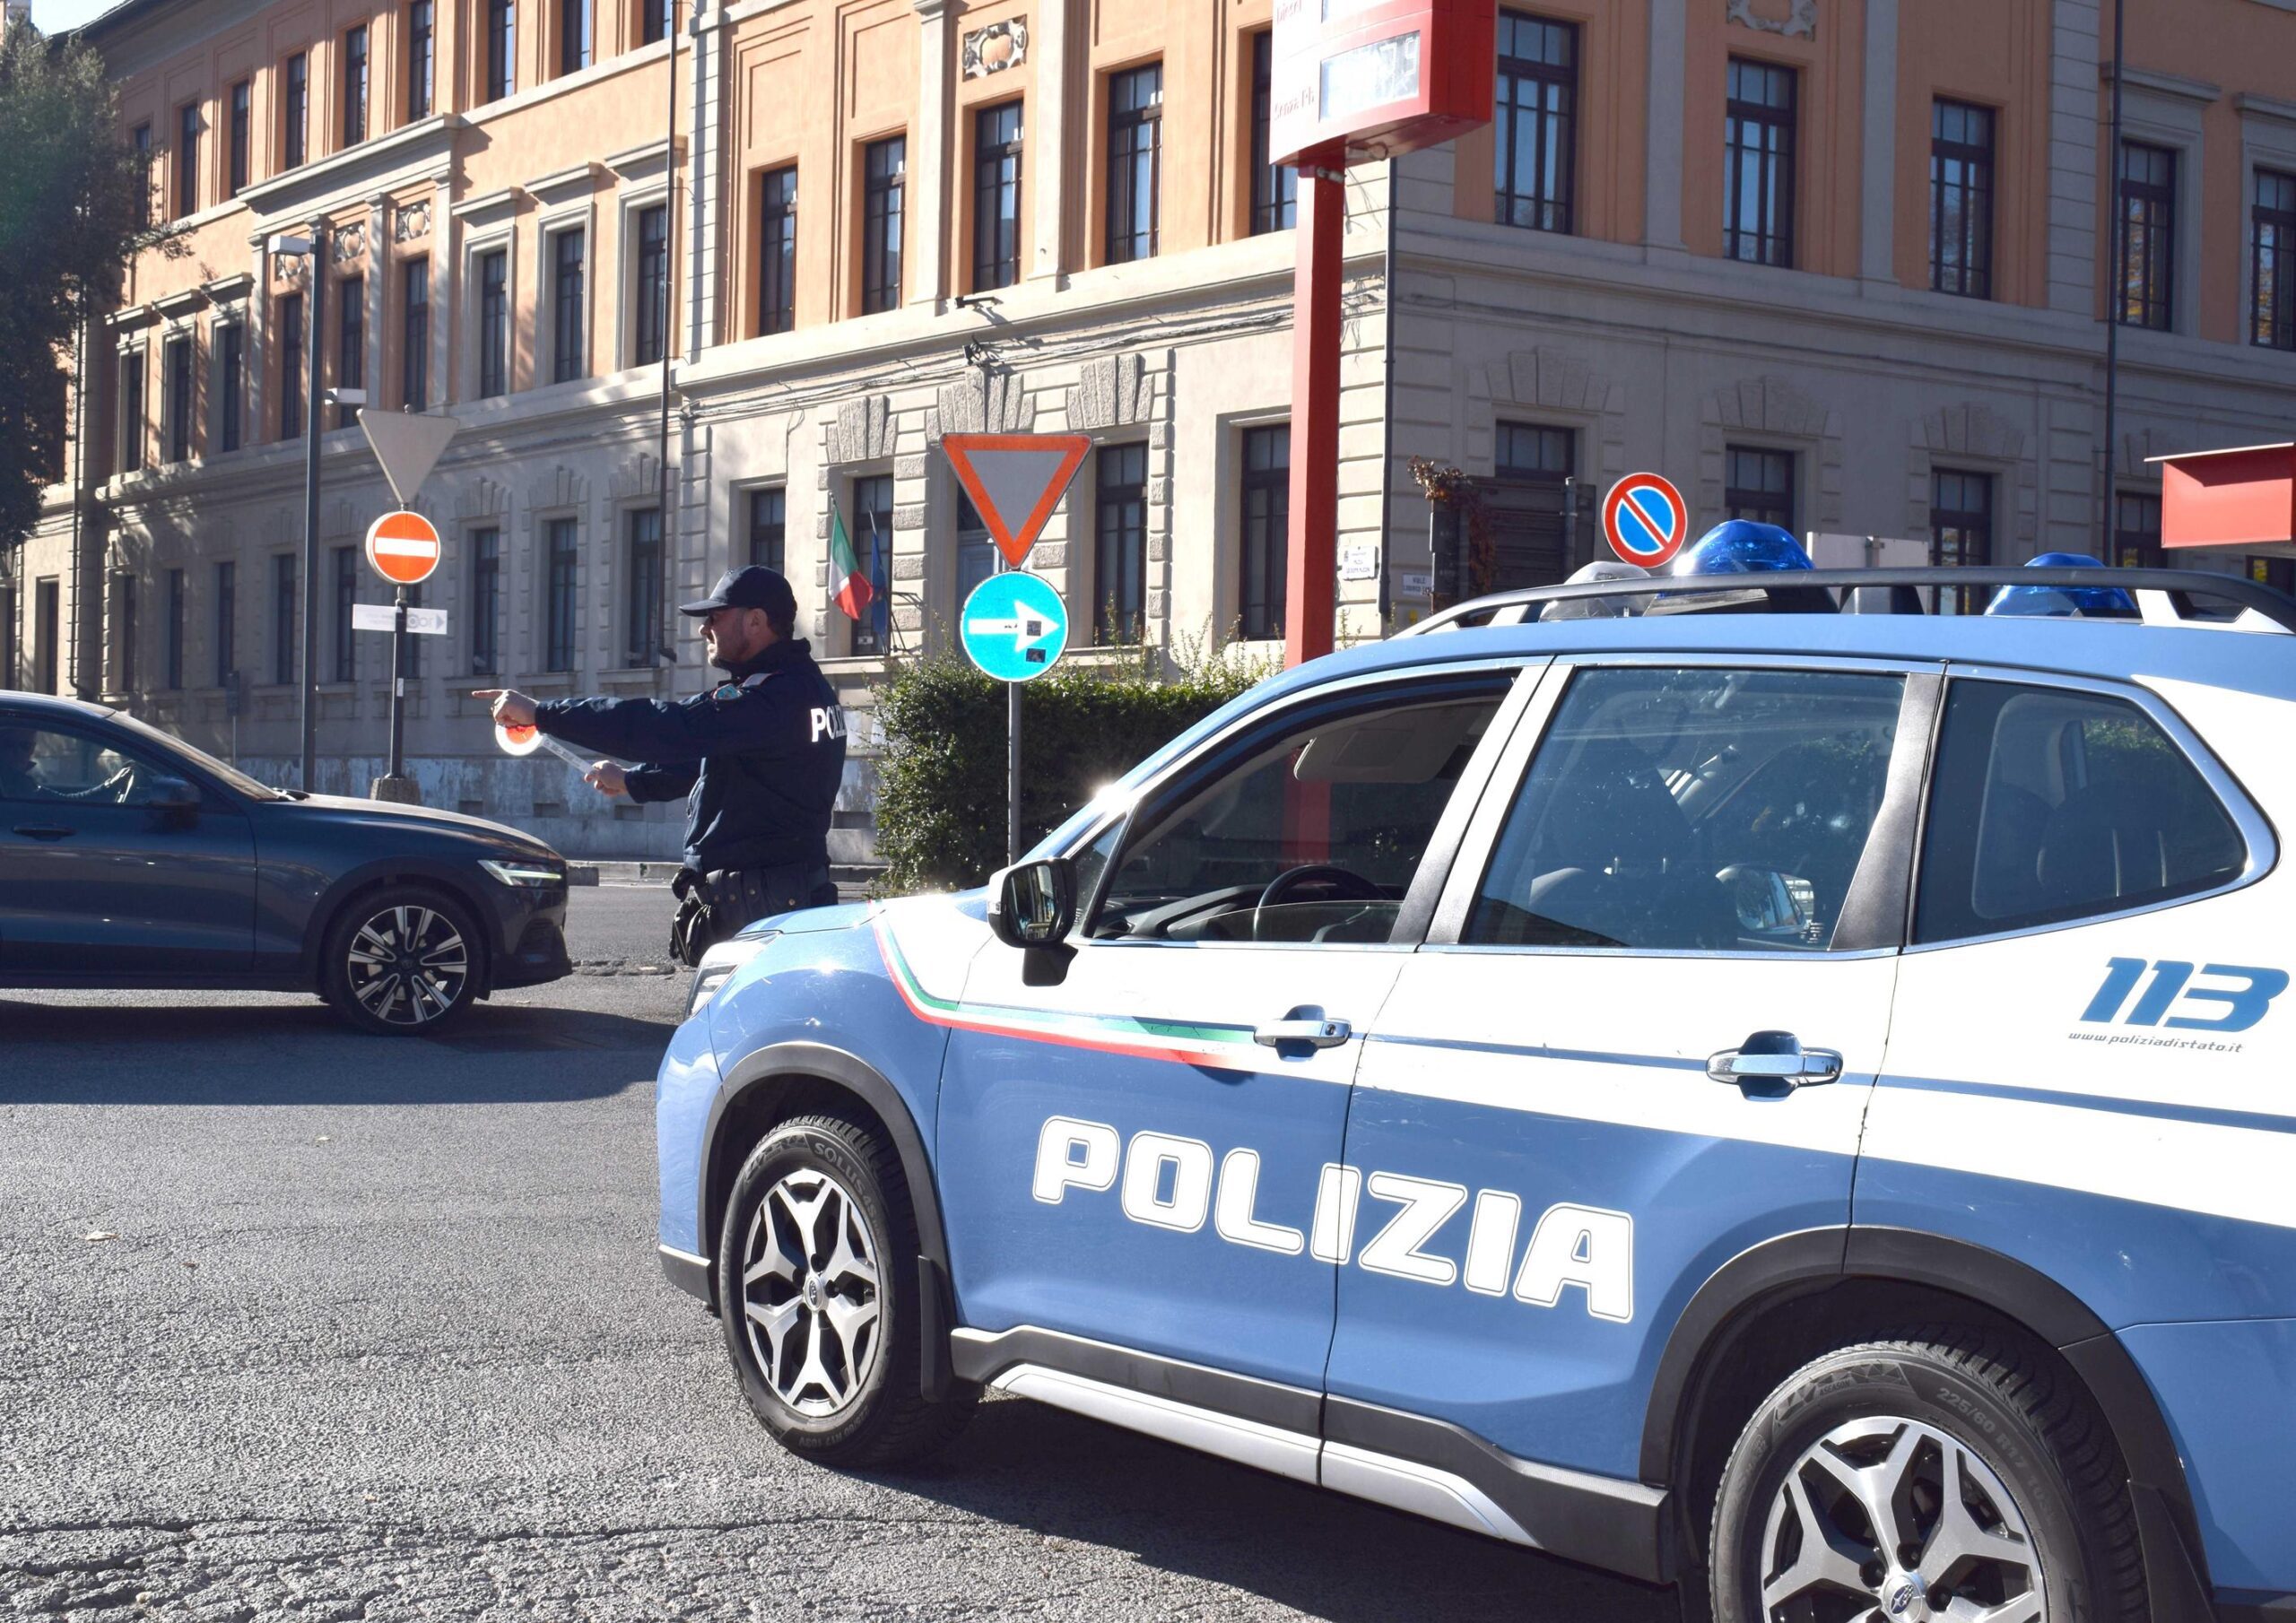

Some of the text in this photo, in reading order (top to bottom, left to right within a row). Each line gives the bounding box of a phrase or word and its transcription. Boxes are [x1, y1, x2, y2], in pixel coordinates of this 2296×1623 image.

[2079, 956, 2291, 1032] 113
[2067, 1031, 2243, 1054] www.poliziadistato.it
[813, 1141, 866, 1196] SOLUS
[1031, 1115, 1635, 1324] POLIZIA
[1936, 1387, 1996, 1434] 225/60
[1996, 1434, 2027, 1469] R17
